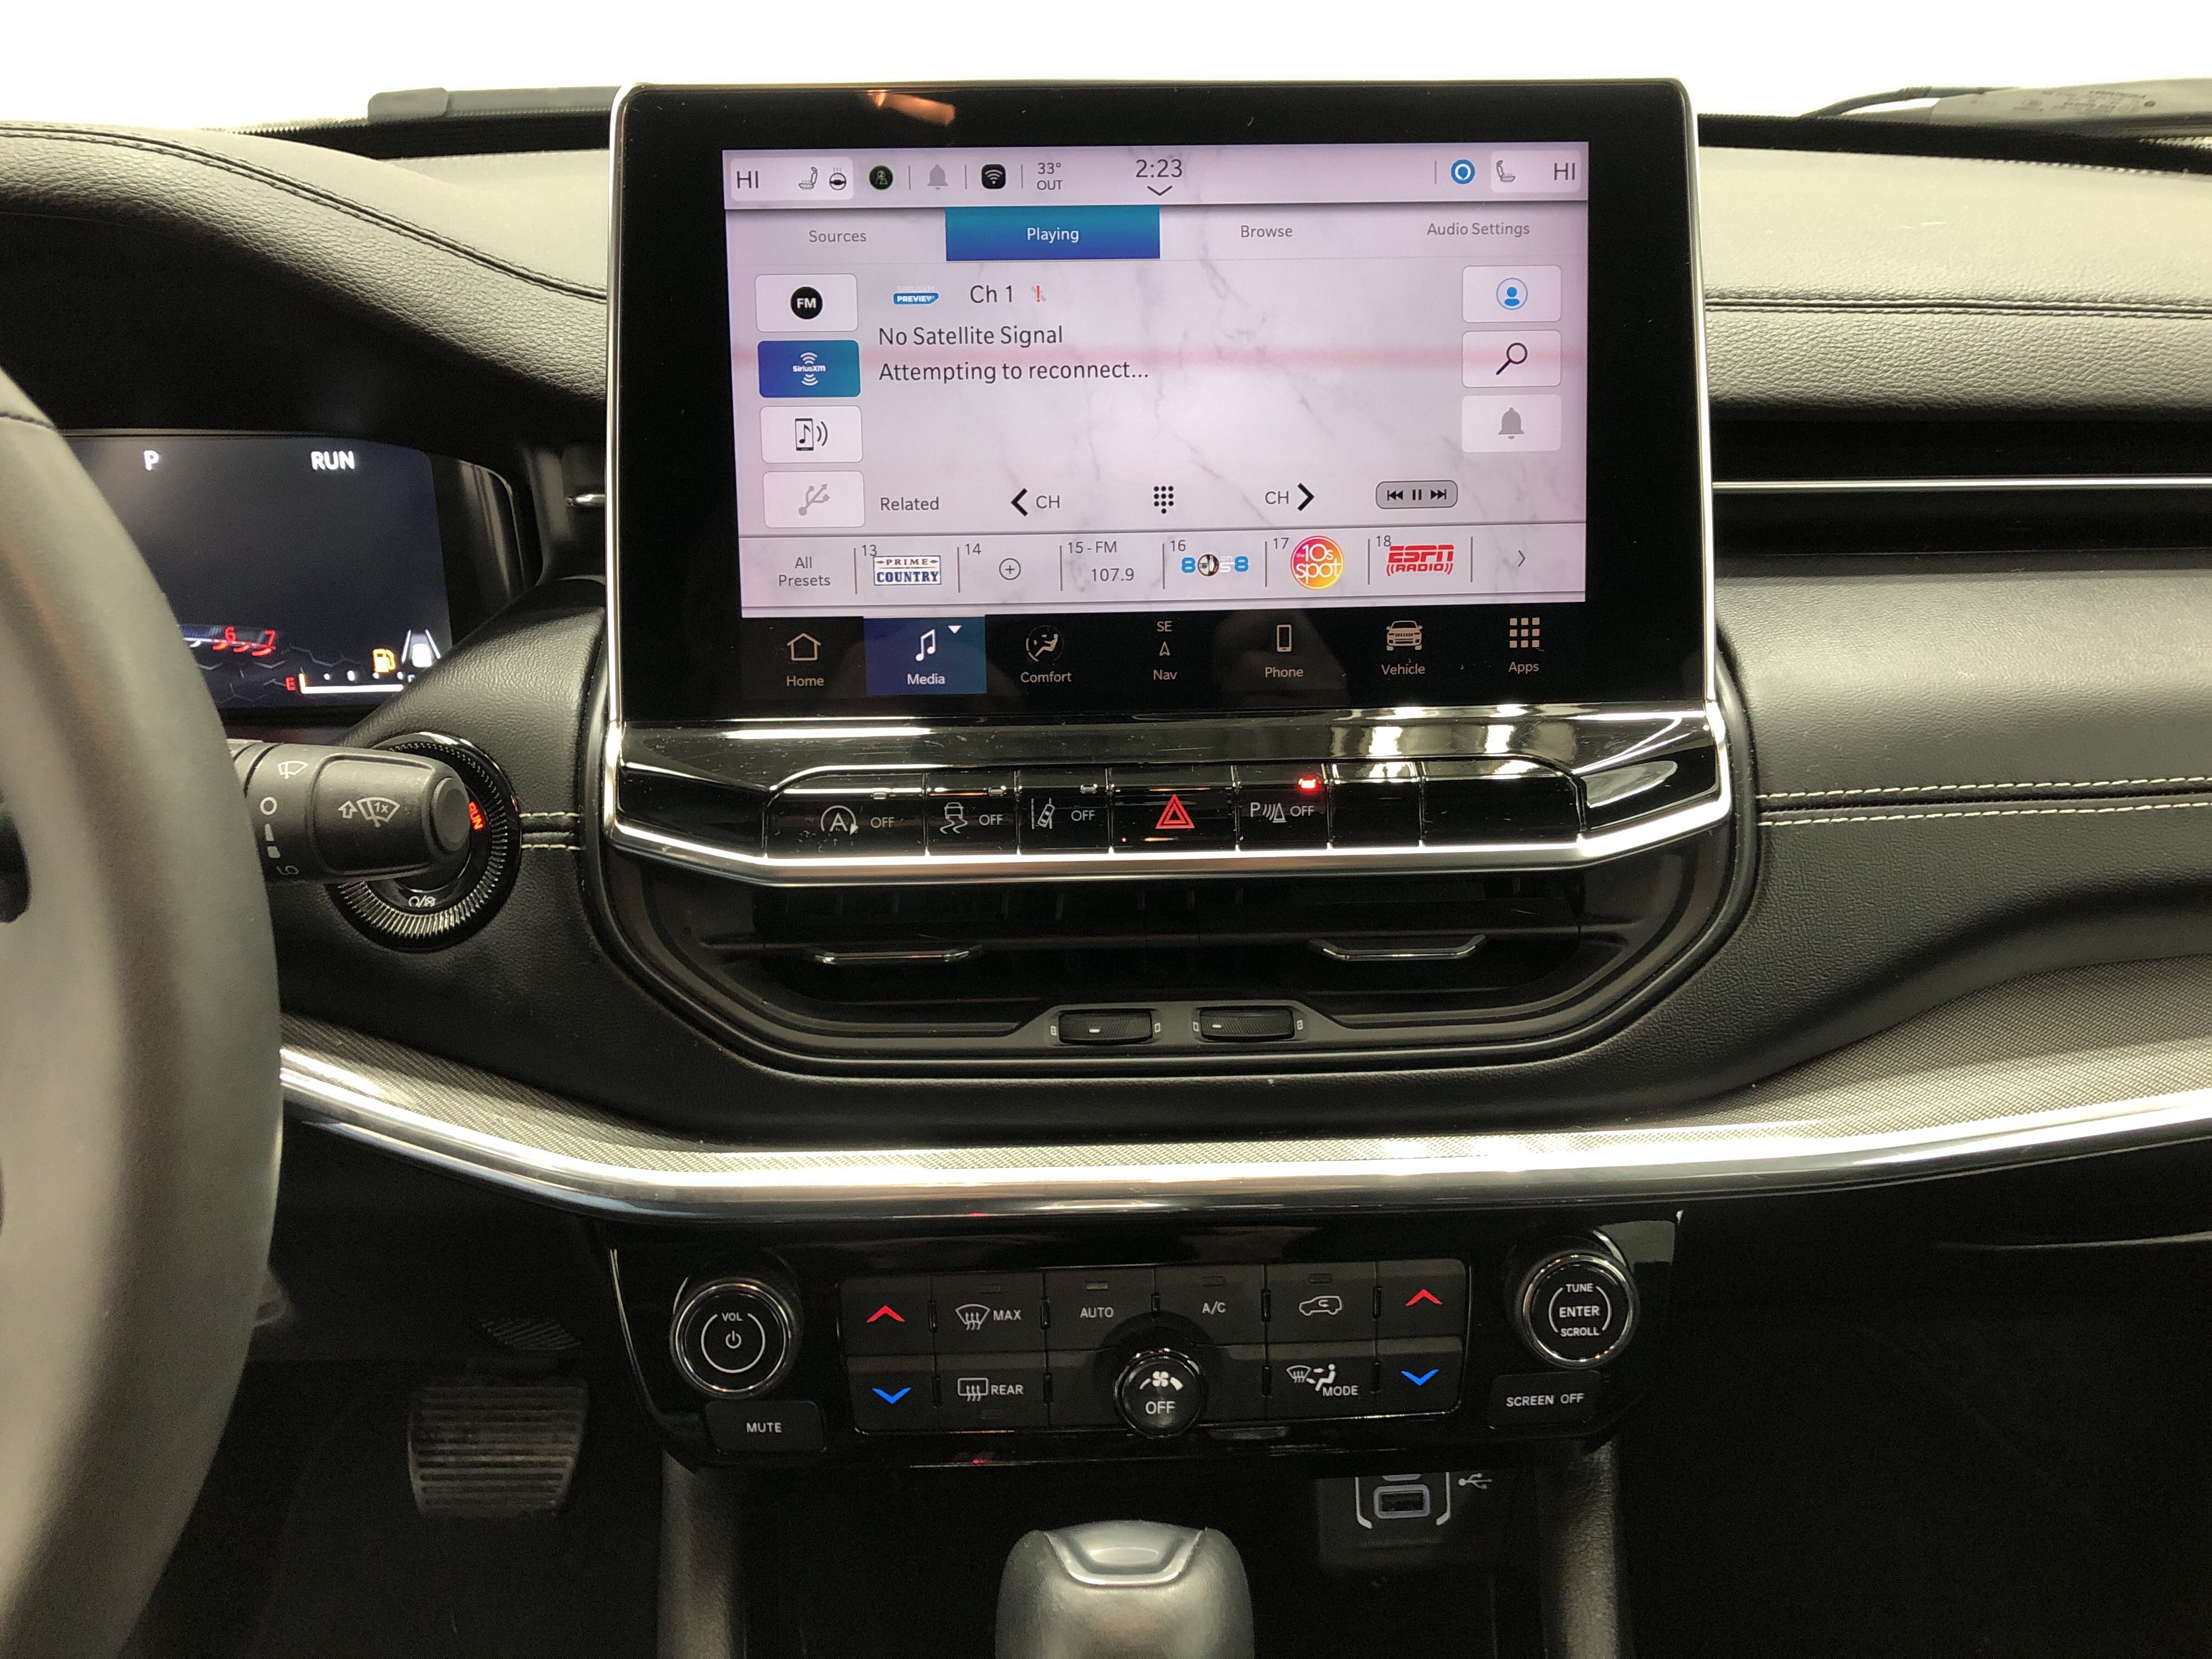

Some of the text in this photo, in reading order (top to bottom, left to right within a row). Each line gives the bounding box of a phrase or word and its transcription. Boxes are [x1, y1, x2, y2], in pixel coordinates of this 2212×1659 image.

[1037, 162, 1061, 174] 33°
[1136, 159, 1182, 178] 2:23
[1554, 162, 1575, 181] HI
[736, 171, 759, 188] HI
[1037, 180, 1063, 190] OUT
[809, 230, 866, 242] Sources
[1027, 228, 1079, 242] Playing
[1240, 225, 1293, 238] Browse
[1427, 222, 1530, 238] Audio Settings
[970, 285, 1013, 303] Ch 1
[797, 298, 816, 309] FM
[879, 326, 1063, 348] No Satellite Signal
[879, 361, 1148, 382] Attempting to reconnect...
[144, 450, 159, 470] P
[311, 451, 354, 470] RUN
[1036, 496, 1060, 509] CH
[1265, 490, 1289, 504] CH
[880, 498, 939, 511] Related
[1171, 540, 1186, 551] 16
[1273, 538, 1289, 550] 17
[1376, 535, 1391, 546] 18
[861, 545, 877, 556] 13
[965, 544, 981, 555] 14
[1067, 542, 1083, 554] 15
[1096, 541, 1117, 553] FM
[1388, 545, 1454, 563] ESPN
[795, 557, 812, 569] All
[1396, 563, 1444, 572] RADIO
[876, 570, 938, 583] COUNTRY
[1091, 568, 1134, 582] 107.9
[1296, 558, 1340, 584] spot
[778, 575, 831, 588] Presets
[1157, 622, 1171, 632] SE
[225, 627, 236, 642] 6
[1265, 665, 1303, 678] Phone
[1381, 663, 1425, 675] Vehicle
[1509, 662, 1539, 675] Apps
[786, 675, 823, 686] Home
[907, 674, 945, 685] Media
[1020, 672, 1071, 684] Comfort
[1153, 670, 1177, 681] Nav
[286, 677, 296, 691] E
[1071, 810, 1095, 821] OFF
[1250, 802, 1314, 817] P OFF
[871, 817, 895, 828] OFF
[979, 815, 1003, 826] OFF
[1566, 1283, 1593, 1293] TUNE
[1080, 1307, 1114, 1318] AUTO
[1202, 1302, 1226, 1314] A/C
[1559, 1306, 1600, 1318] ENTER
[722, 1312, 742, 1322] VOL
[993, 1309, 1021, 1321] MAX
[1560, 1327, 1600, 1337] SCROLL
[990, 1384, 1024, 1396] REAR
[1322, 1386, 1358, 1397] MODE
[1506, 1392, 1584, 1407] SCREEN OFF
[1145, 1401, 1176, 1415] OFF
[747, 1422, 782, 1434] MUTE
